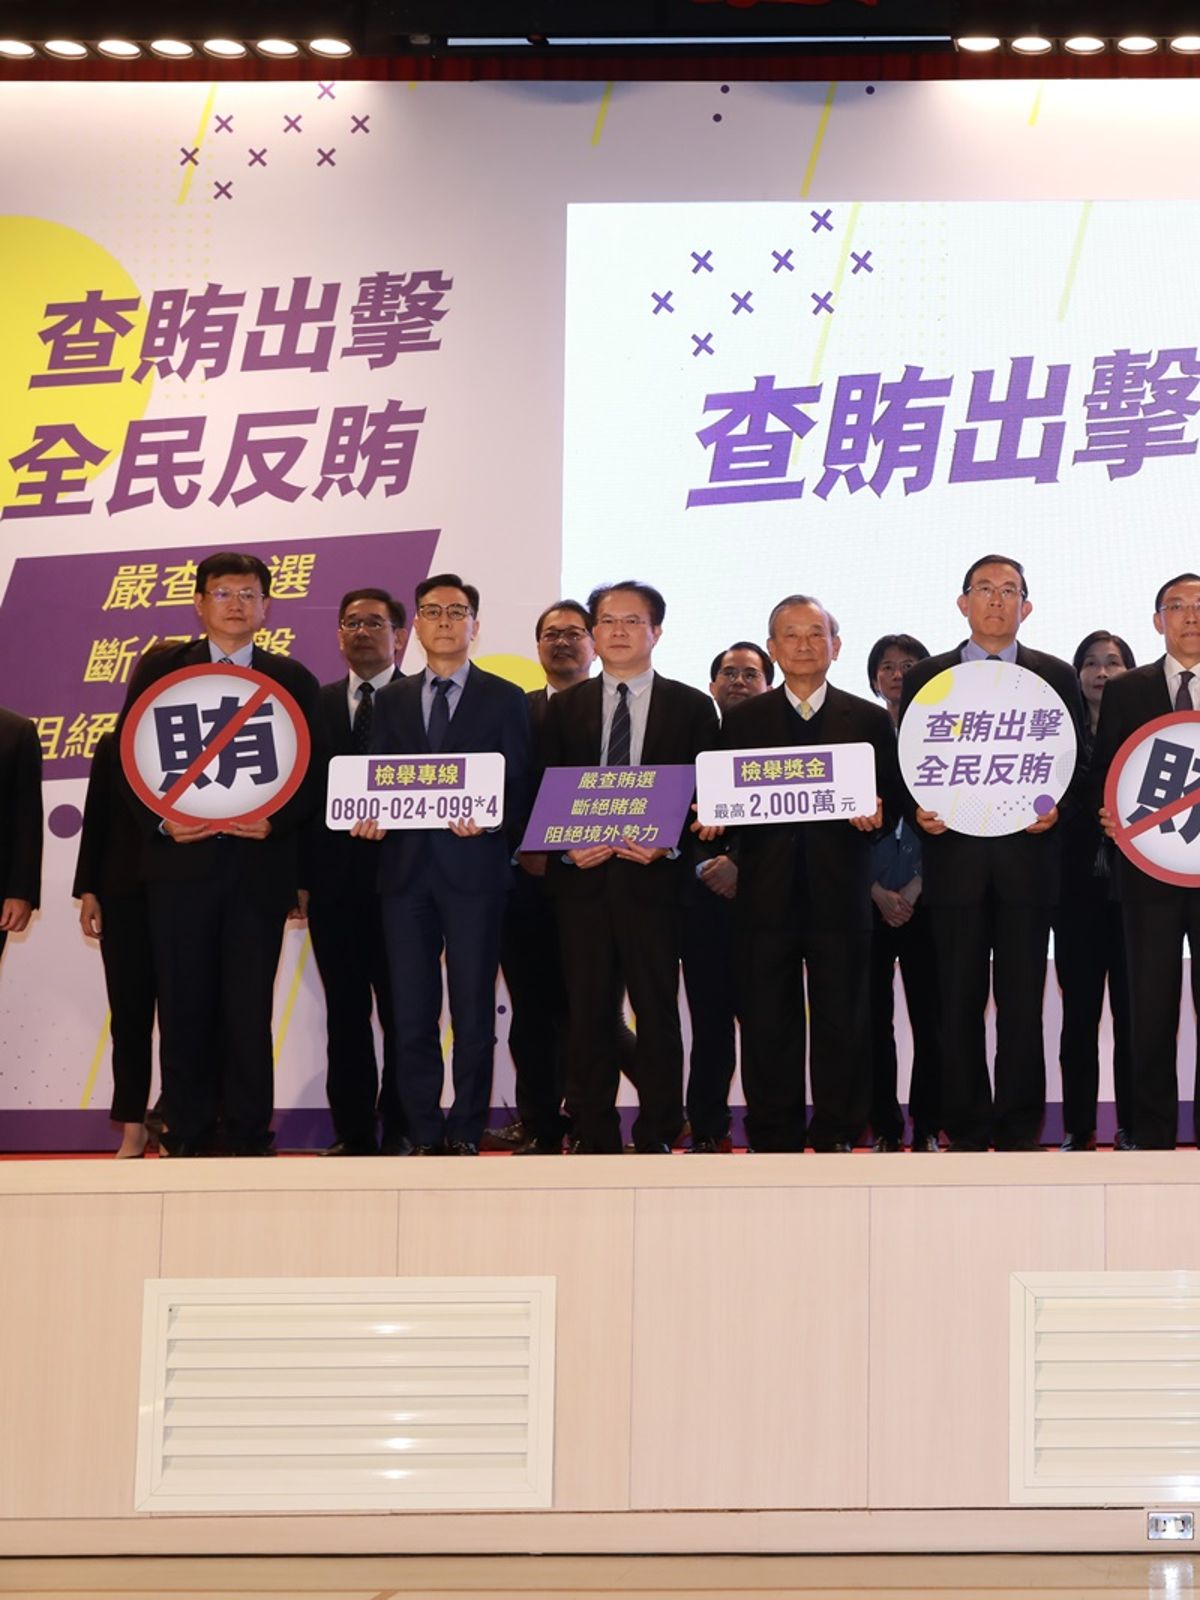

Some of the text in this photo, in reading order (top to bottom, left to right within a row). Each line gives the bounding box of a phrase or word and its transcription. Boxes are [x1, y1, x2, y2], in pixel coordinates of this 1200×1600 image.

[28, 269, 454, 390] 查賄出擊
[0, 399, 427, 522] 全民反賄
[102, 553, 316, 611] 嚴查選
[923, 708, 1064, 743] 查賄出擊
[154, 696, 279, 792] 賄
[374, 763, 459, 786] 檢舉專線
[577, 771, 657, 789] 嚴查賄選
[741, 757, 826, 782] 檢舉獎金
[914, 751, 1054, 787] 全民反賄
[570, 797, 648, 816] 斷絕賭盤
[714, 803, 746, 819] 最高
[840, 797, 856, 812] 元
[544, 824, 659, 843] 阻絕境外勢力
